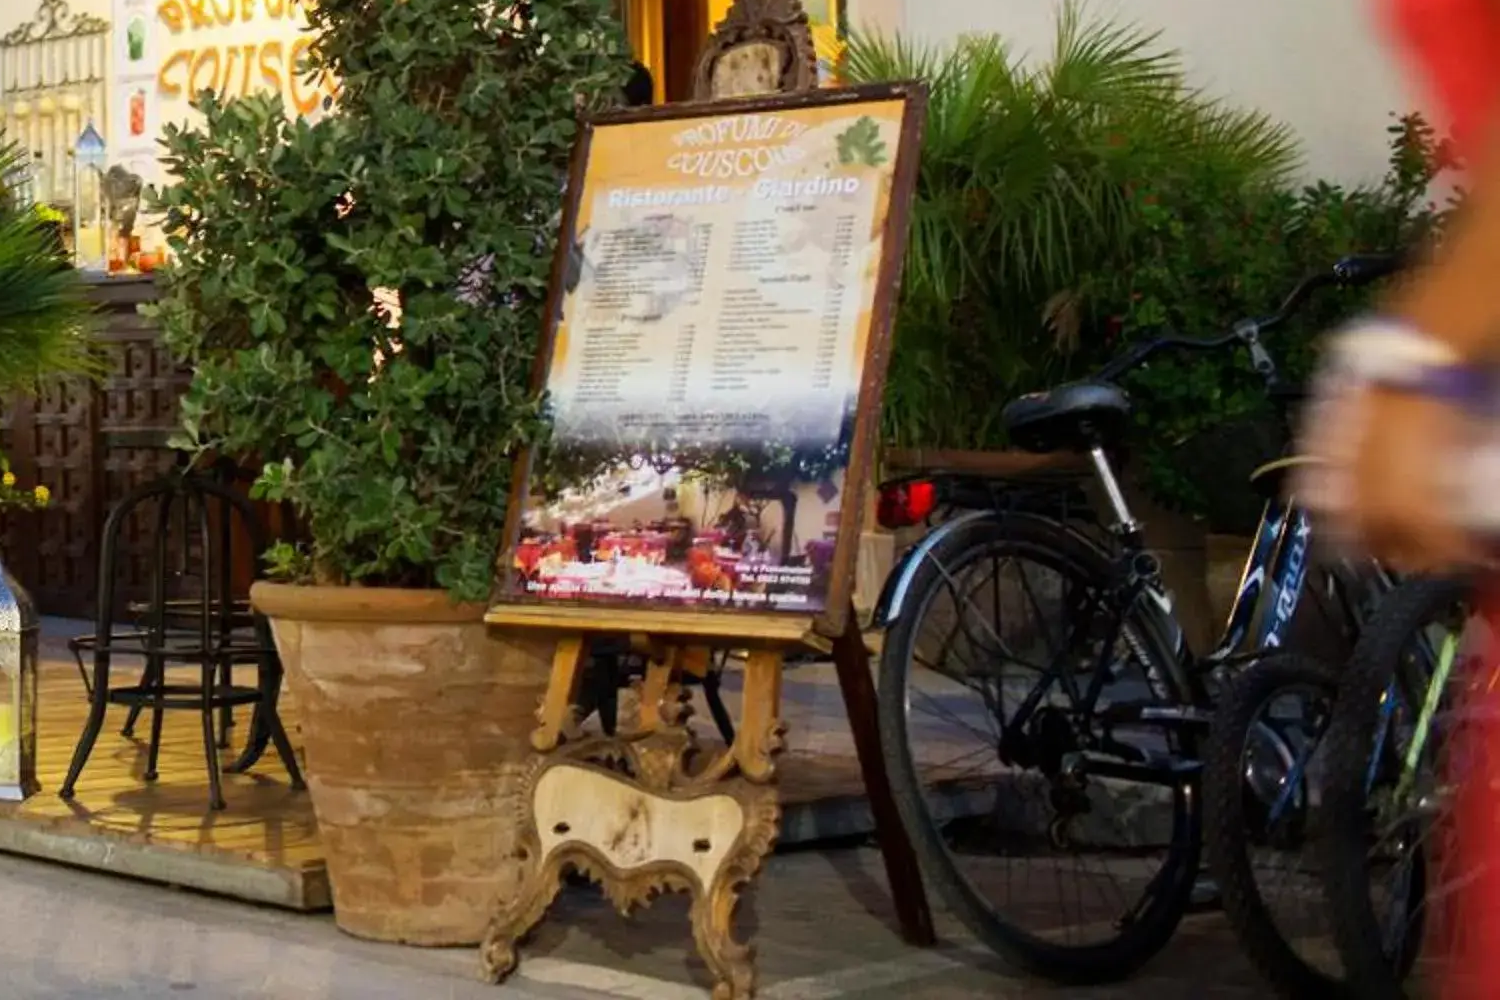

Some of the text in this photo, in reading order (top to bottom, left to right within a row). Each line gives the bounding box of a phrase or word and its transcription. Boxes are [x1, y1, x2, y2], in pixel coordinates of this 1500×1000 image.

[156, 36, 342, 116] COUSC
[609, 175, 860, 207] Ristorante Giardino
